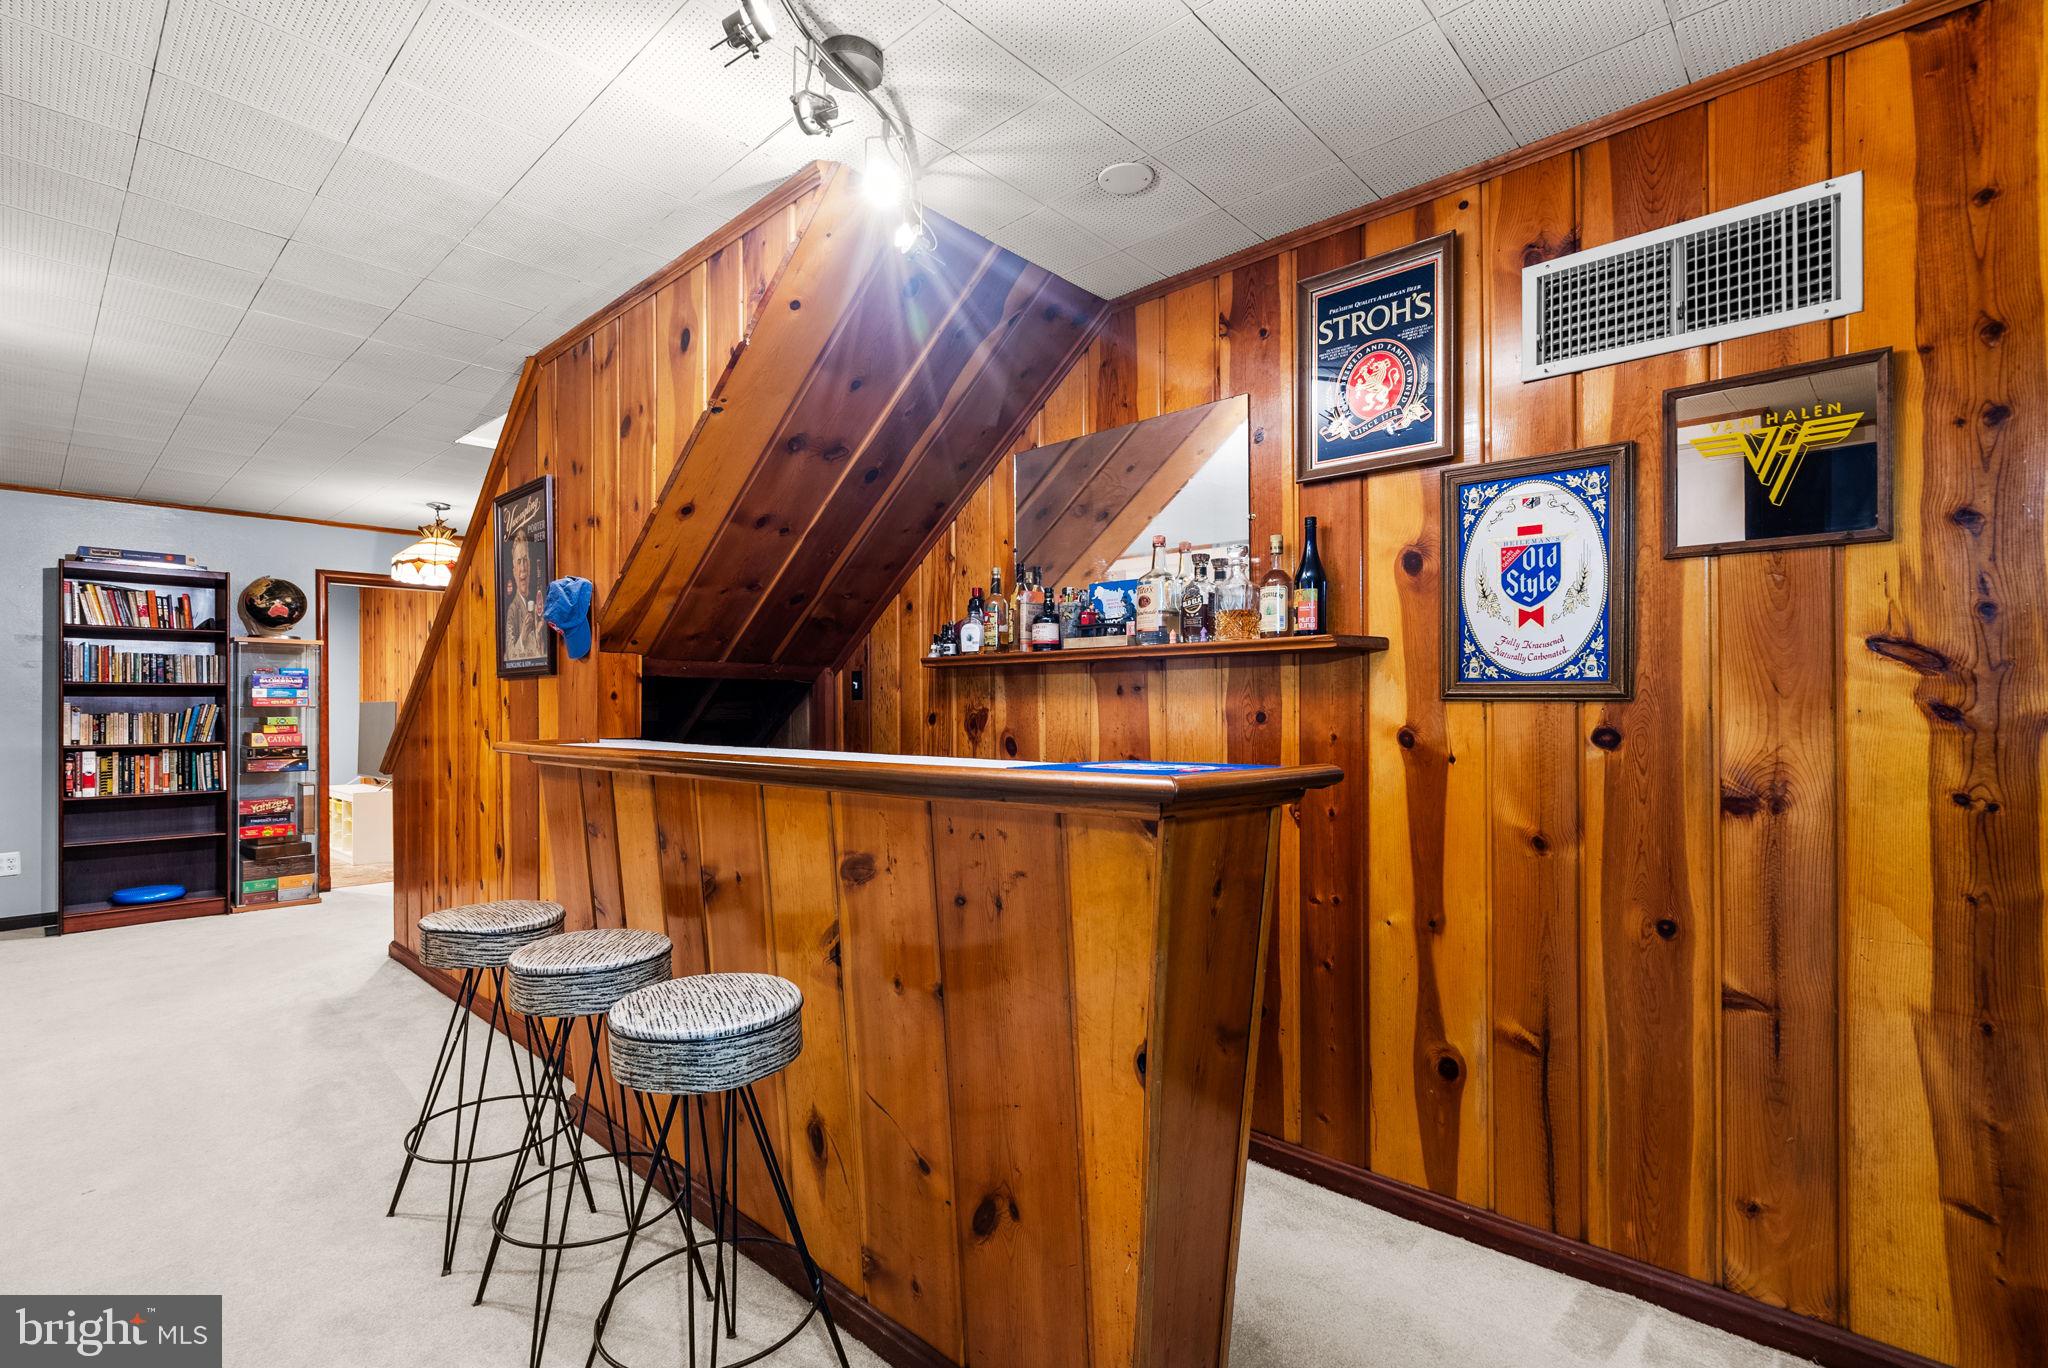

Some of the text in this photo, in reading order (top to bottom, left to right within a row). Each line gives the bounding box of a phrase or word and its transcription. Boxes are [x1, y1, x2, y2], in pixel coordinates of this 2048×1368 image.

[1329, 284, 1422, 315] PREMIUM QUALITY AMERICAN BEER
[1318, 291, 1432, 345] STROH'S
[1365, 343, 1384, 353] AND
[1387, 344, 1411, 367] FAMILY
[1401, 369, 1413, 403] OWNED
[1354, 409, 1398, 436] SINCE 1775
[1709, 401, 1842, 433] VAN HALEN
[527, 519, 546, 534] PORTER
[534, 531, 546, 543] BEER
[1522, 544, 1557, 571] Old
[1505, 569, 1558, 603] Style
[1490, 645, 1526, 665] Naturally
[1494, 633, 1565, 651] Fully Kraeusened
[267, 735, 292, 743] CATAN
[250, 798, 289, 813] Yahtzee
